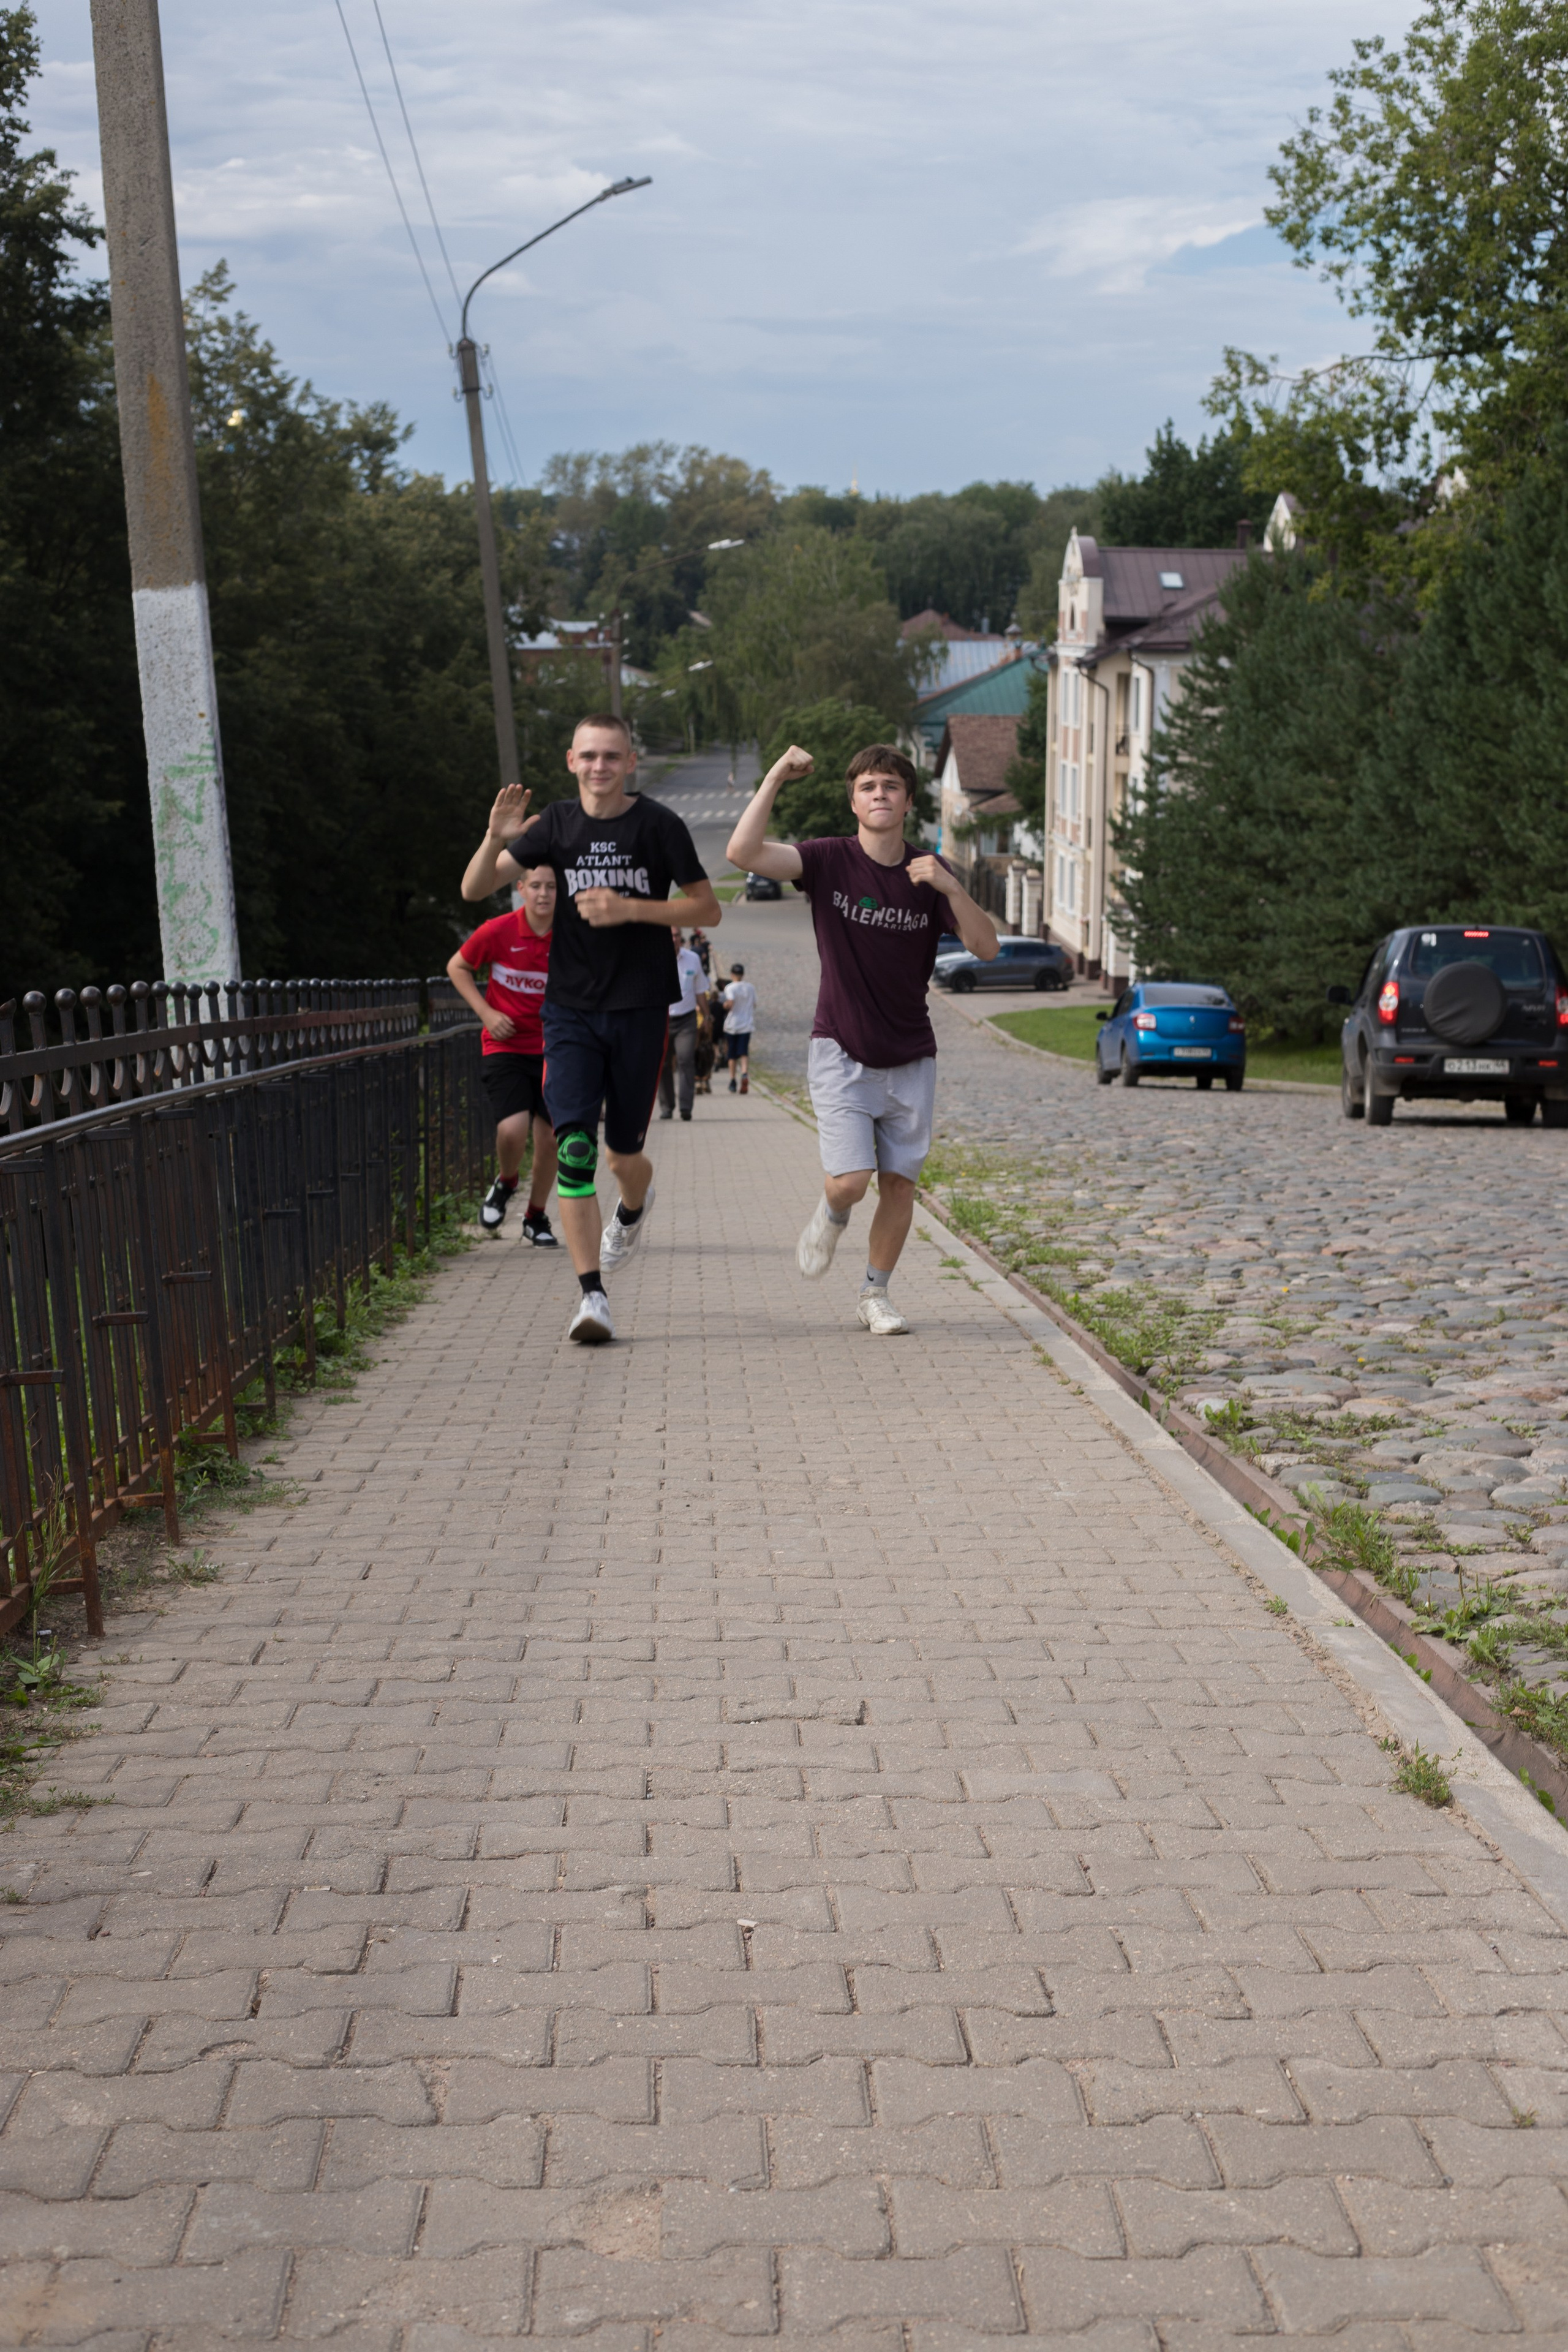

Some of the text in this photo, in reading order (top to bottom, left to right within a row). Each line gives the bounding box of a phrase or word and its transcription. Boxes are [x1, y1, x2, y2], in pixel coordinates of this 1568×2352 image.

[590, 841, 617, 853] KSC
[576, 854, 632, 867] ATLANT
[564, 866, 651, 897] BOXING
[833, 891, 928, 930] BALENCIAGA
[877, 920, 908, 931] PARIS
[506, 974, 546, 990] ЛУКО
